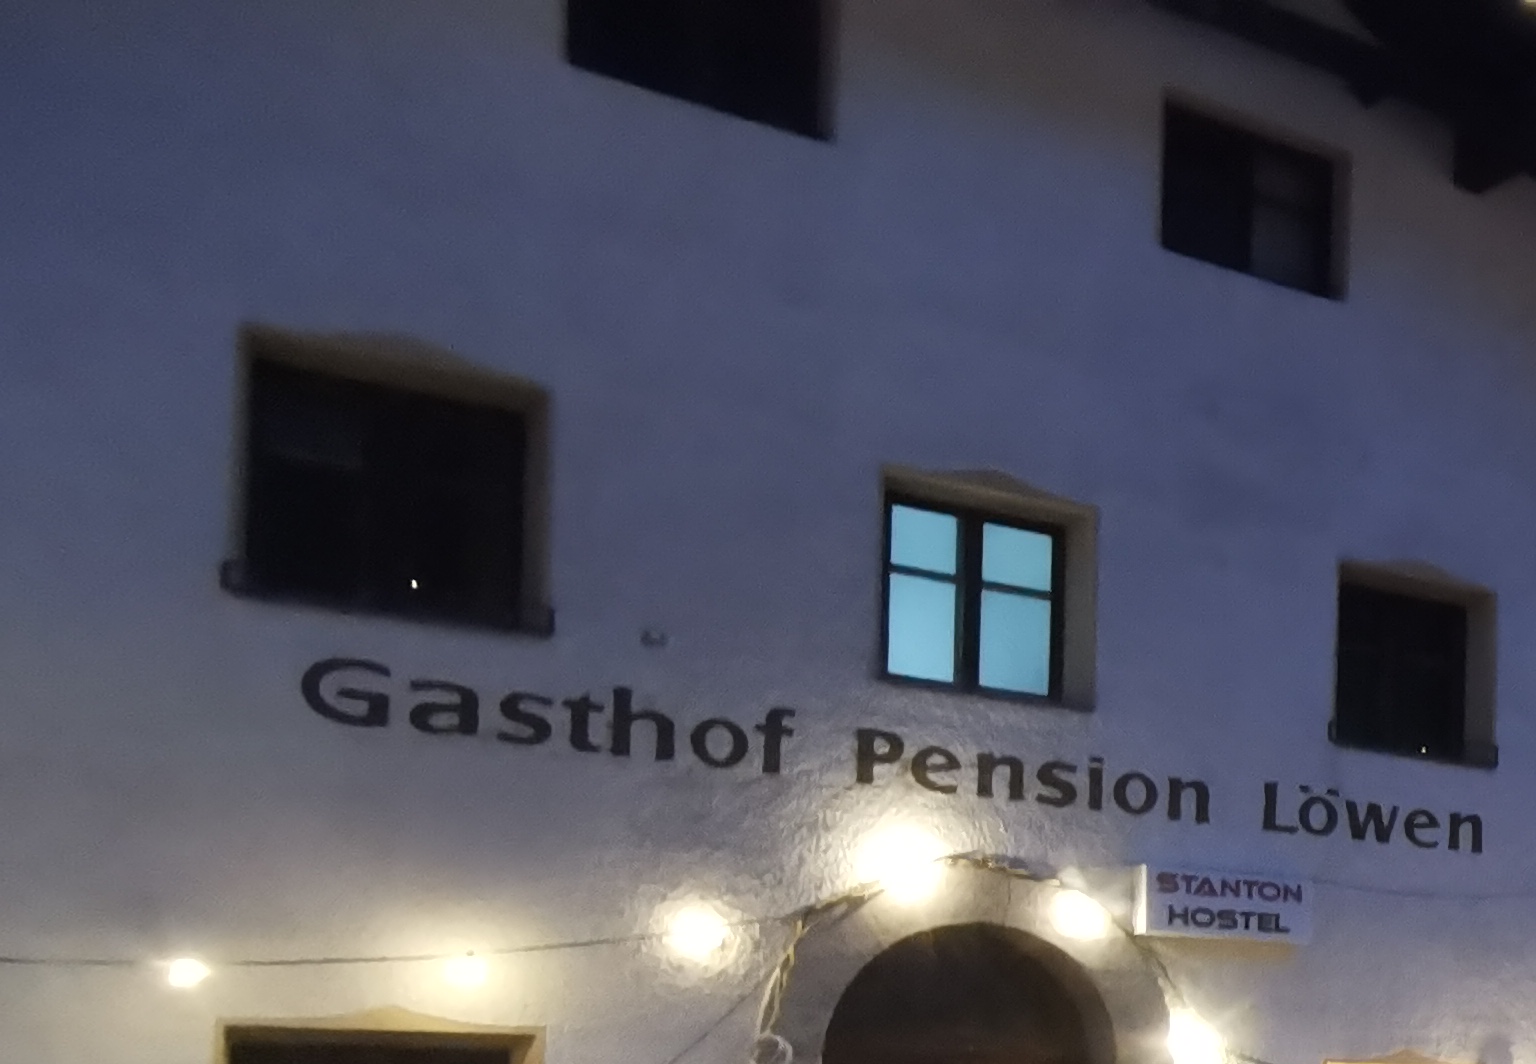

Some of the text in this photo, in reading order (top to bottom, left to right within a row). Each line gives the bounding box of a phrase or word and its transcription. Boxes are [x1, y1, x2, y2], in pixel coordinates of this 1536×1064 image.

[300, 656, 1485, 854] Gasthof Pension Löwen
[1168, 904, 1291, 933] HOSTEL
